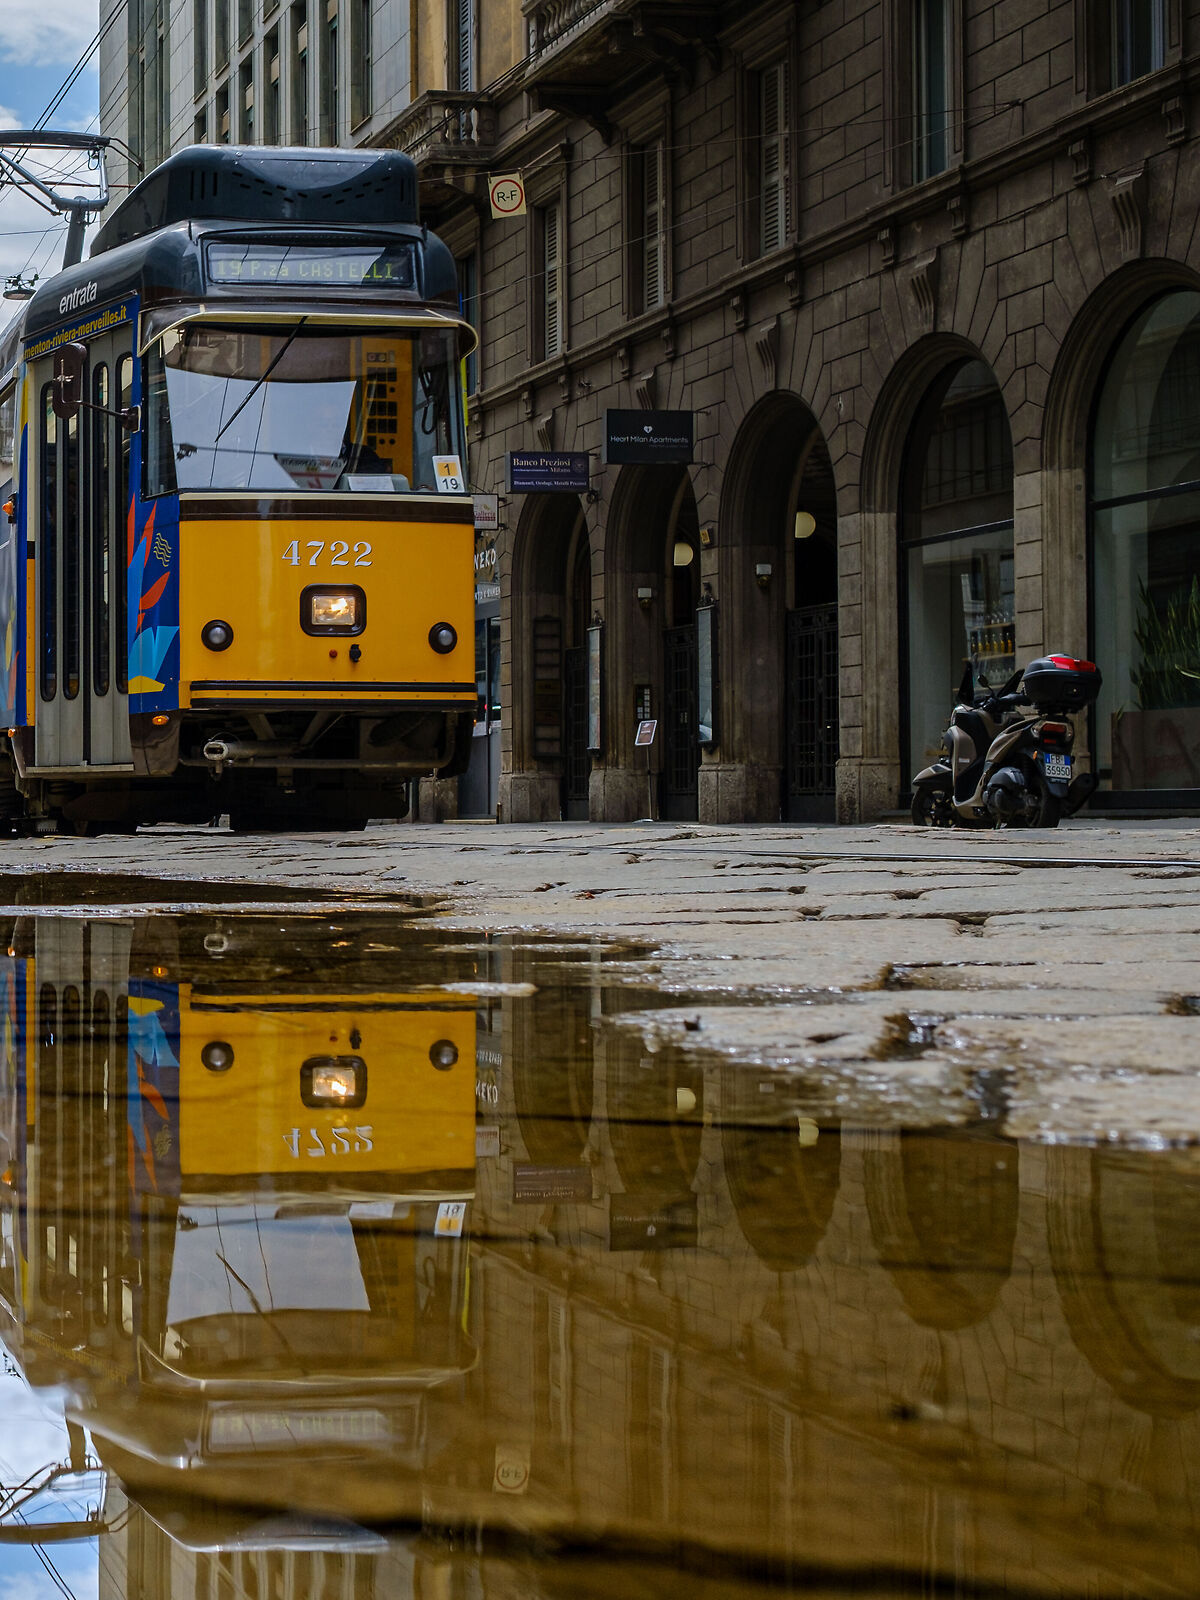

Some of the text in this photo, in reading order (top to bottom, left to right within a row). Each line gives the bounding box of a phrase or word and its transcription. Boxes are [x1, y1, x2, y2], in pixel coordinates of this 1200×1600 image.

[496, 189, 518, 203] R-F
[216, 260, 242, 277] 19
[299, 262, 393, 279] CASTELLI
[59, 280, 98, 315] entrata
[24, 304, 127, 359] menton-riviera-merveilles.it
[610, 435, 689, 444] Heart Milan Apartments
[443, 463, 451, 476] 1
[513, 458, 571, 467] Banco Preziosi
[442, 478, 459, 490] 19
[281, 540, 373, 567] 4722
